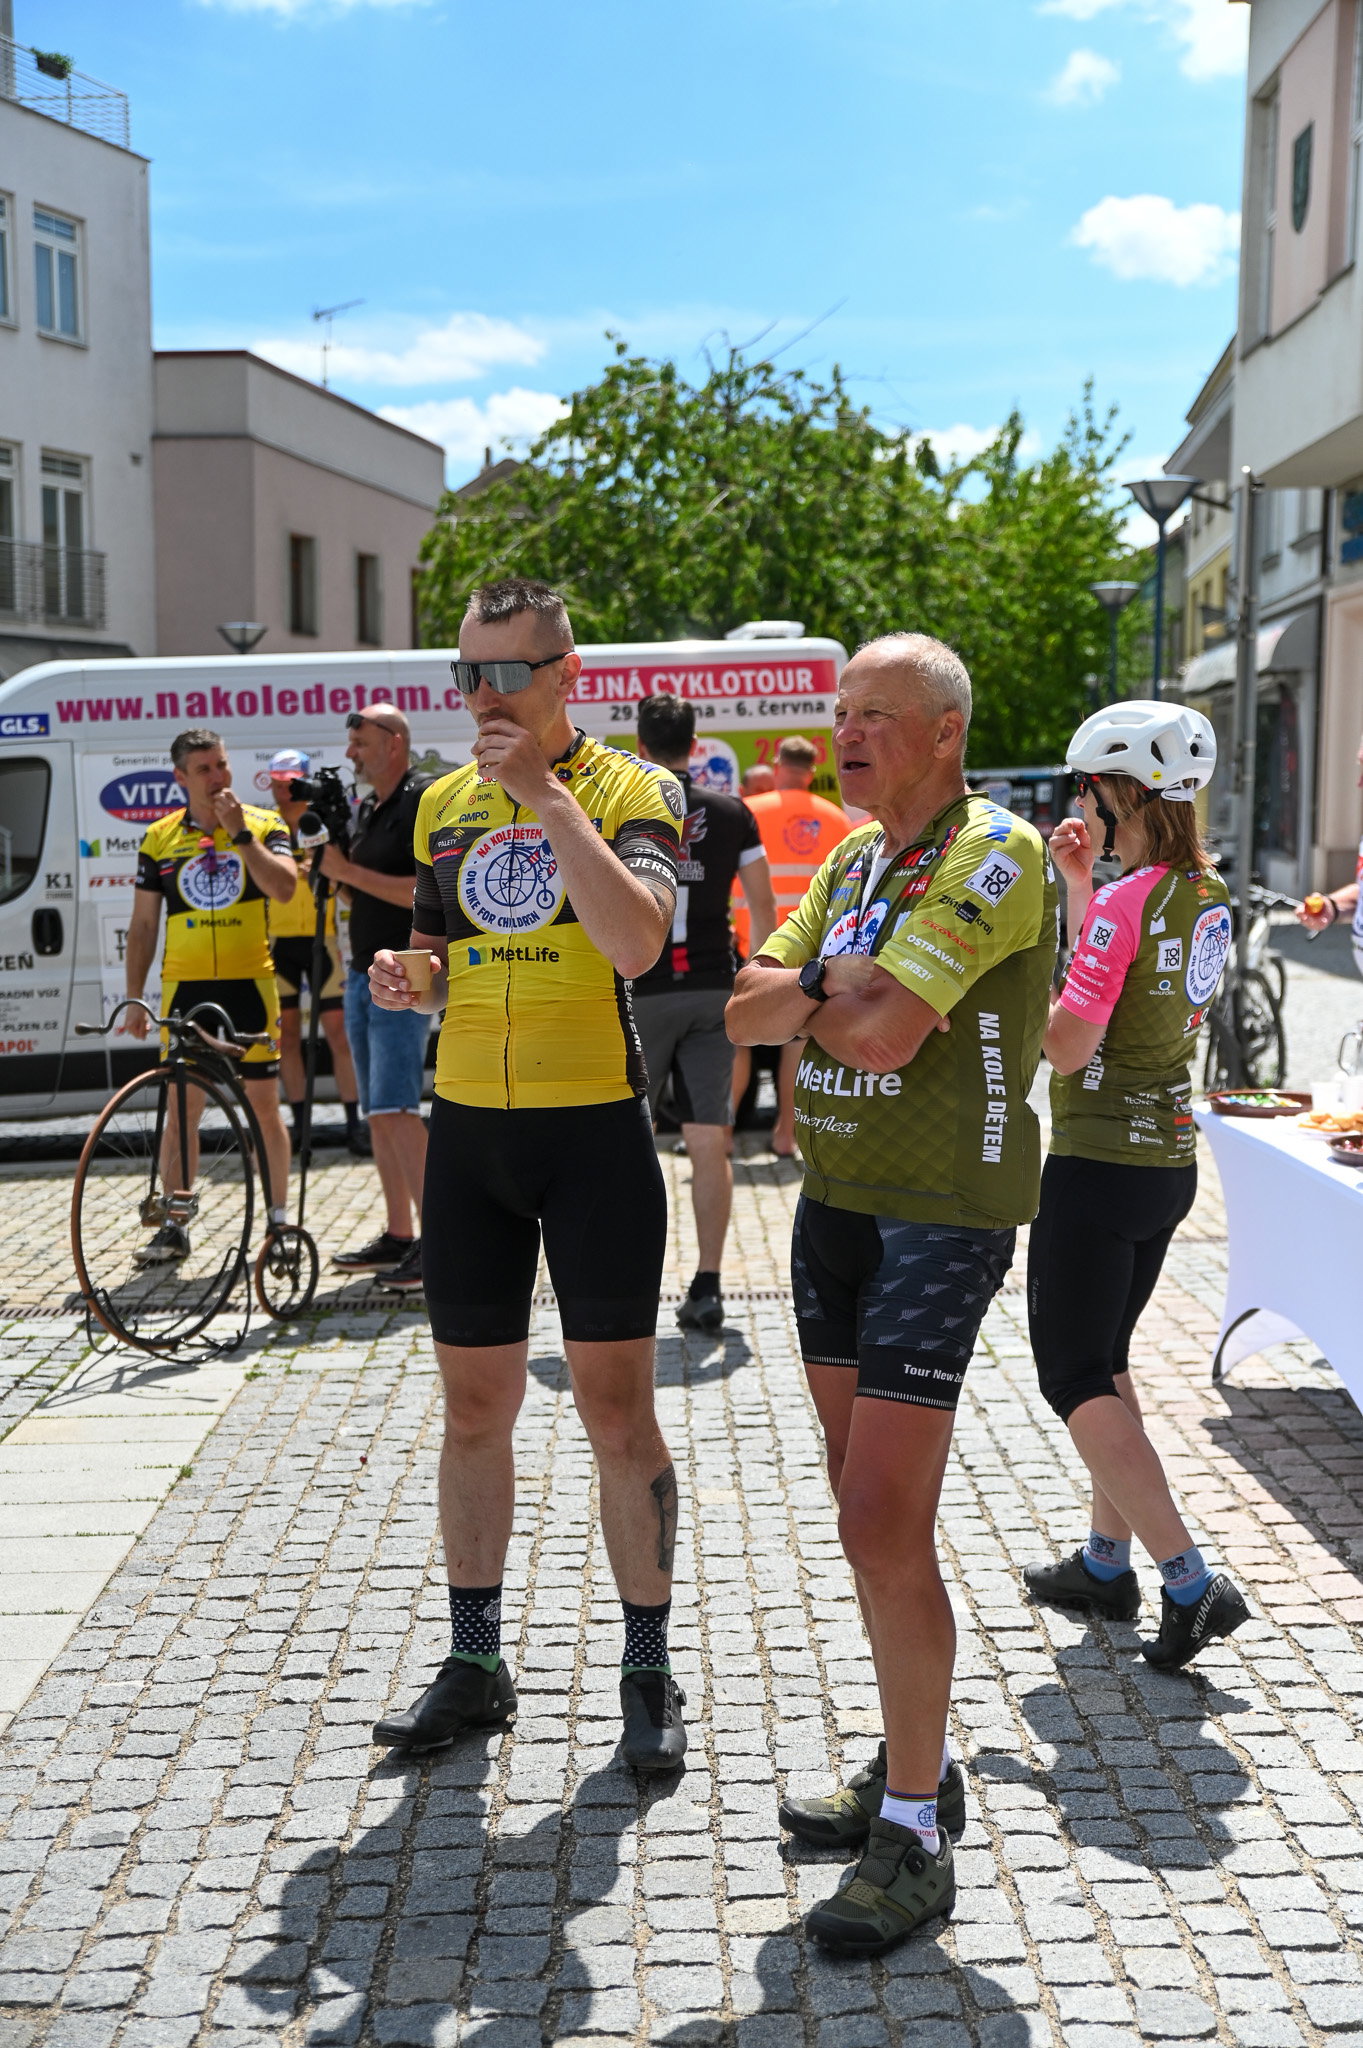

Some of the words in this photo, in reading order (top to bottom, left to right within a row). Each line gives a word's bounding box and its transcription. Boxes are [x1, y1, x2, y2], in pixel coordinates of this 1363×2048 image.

[568, 669, 645, 701] EJNÁ
[651, 667, 815, 697] CYKLOTOUR
[56, 682, 468, 724] www.nakoledetem.c
[759, 699, 826, 716] června
[118, 782, 188, 806] VITA
[459, 811, 489, 823] AMPO
[477, 843, 491, 858] NA
[490, 829, 511, 847] KOLE
[45, 873, 73, 889] K1
[466, 870, 477, 885] ON
[465, 887, 481, 911] BIKE
[200, 918, 242, 929] MetLife
[477, 907, 497, 925] FOR
[497, 911, 541, 928] CHILDREN
[974, 915, 993, 936] kraj
[491, 946, 560, 963] MetLife
[906, 934, 965, 975] OSTRAVA!!!
[978, 1012, 999, 1040] NA
[1183, 1007, 1209, 1033] SMO
[796, 1059, 902, 1097] MetLife
[981, 1045, 1006, 1096] KOLE
[982, 1101, 1008, 1163] DĚTEM
[904, 1364, 931, 1378] Tour
[933, 1369, 954, 1383] New
[1190, 1575, 1225, 1639] SPECIALIZED
[919, 1828, 936, 1838] KOLE
